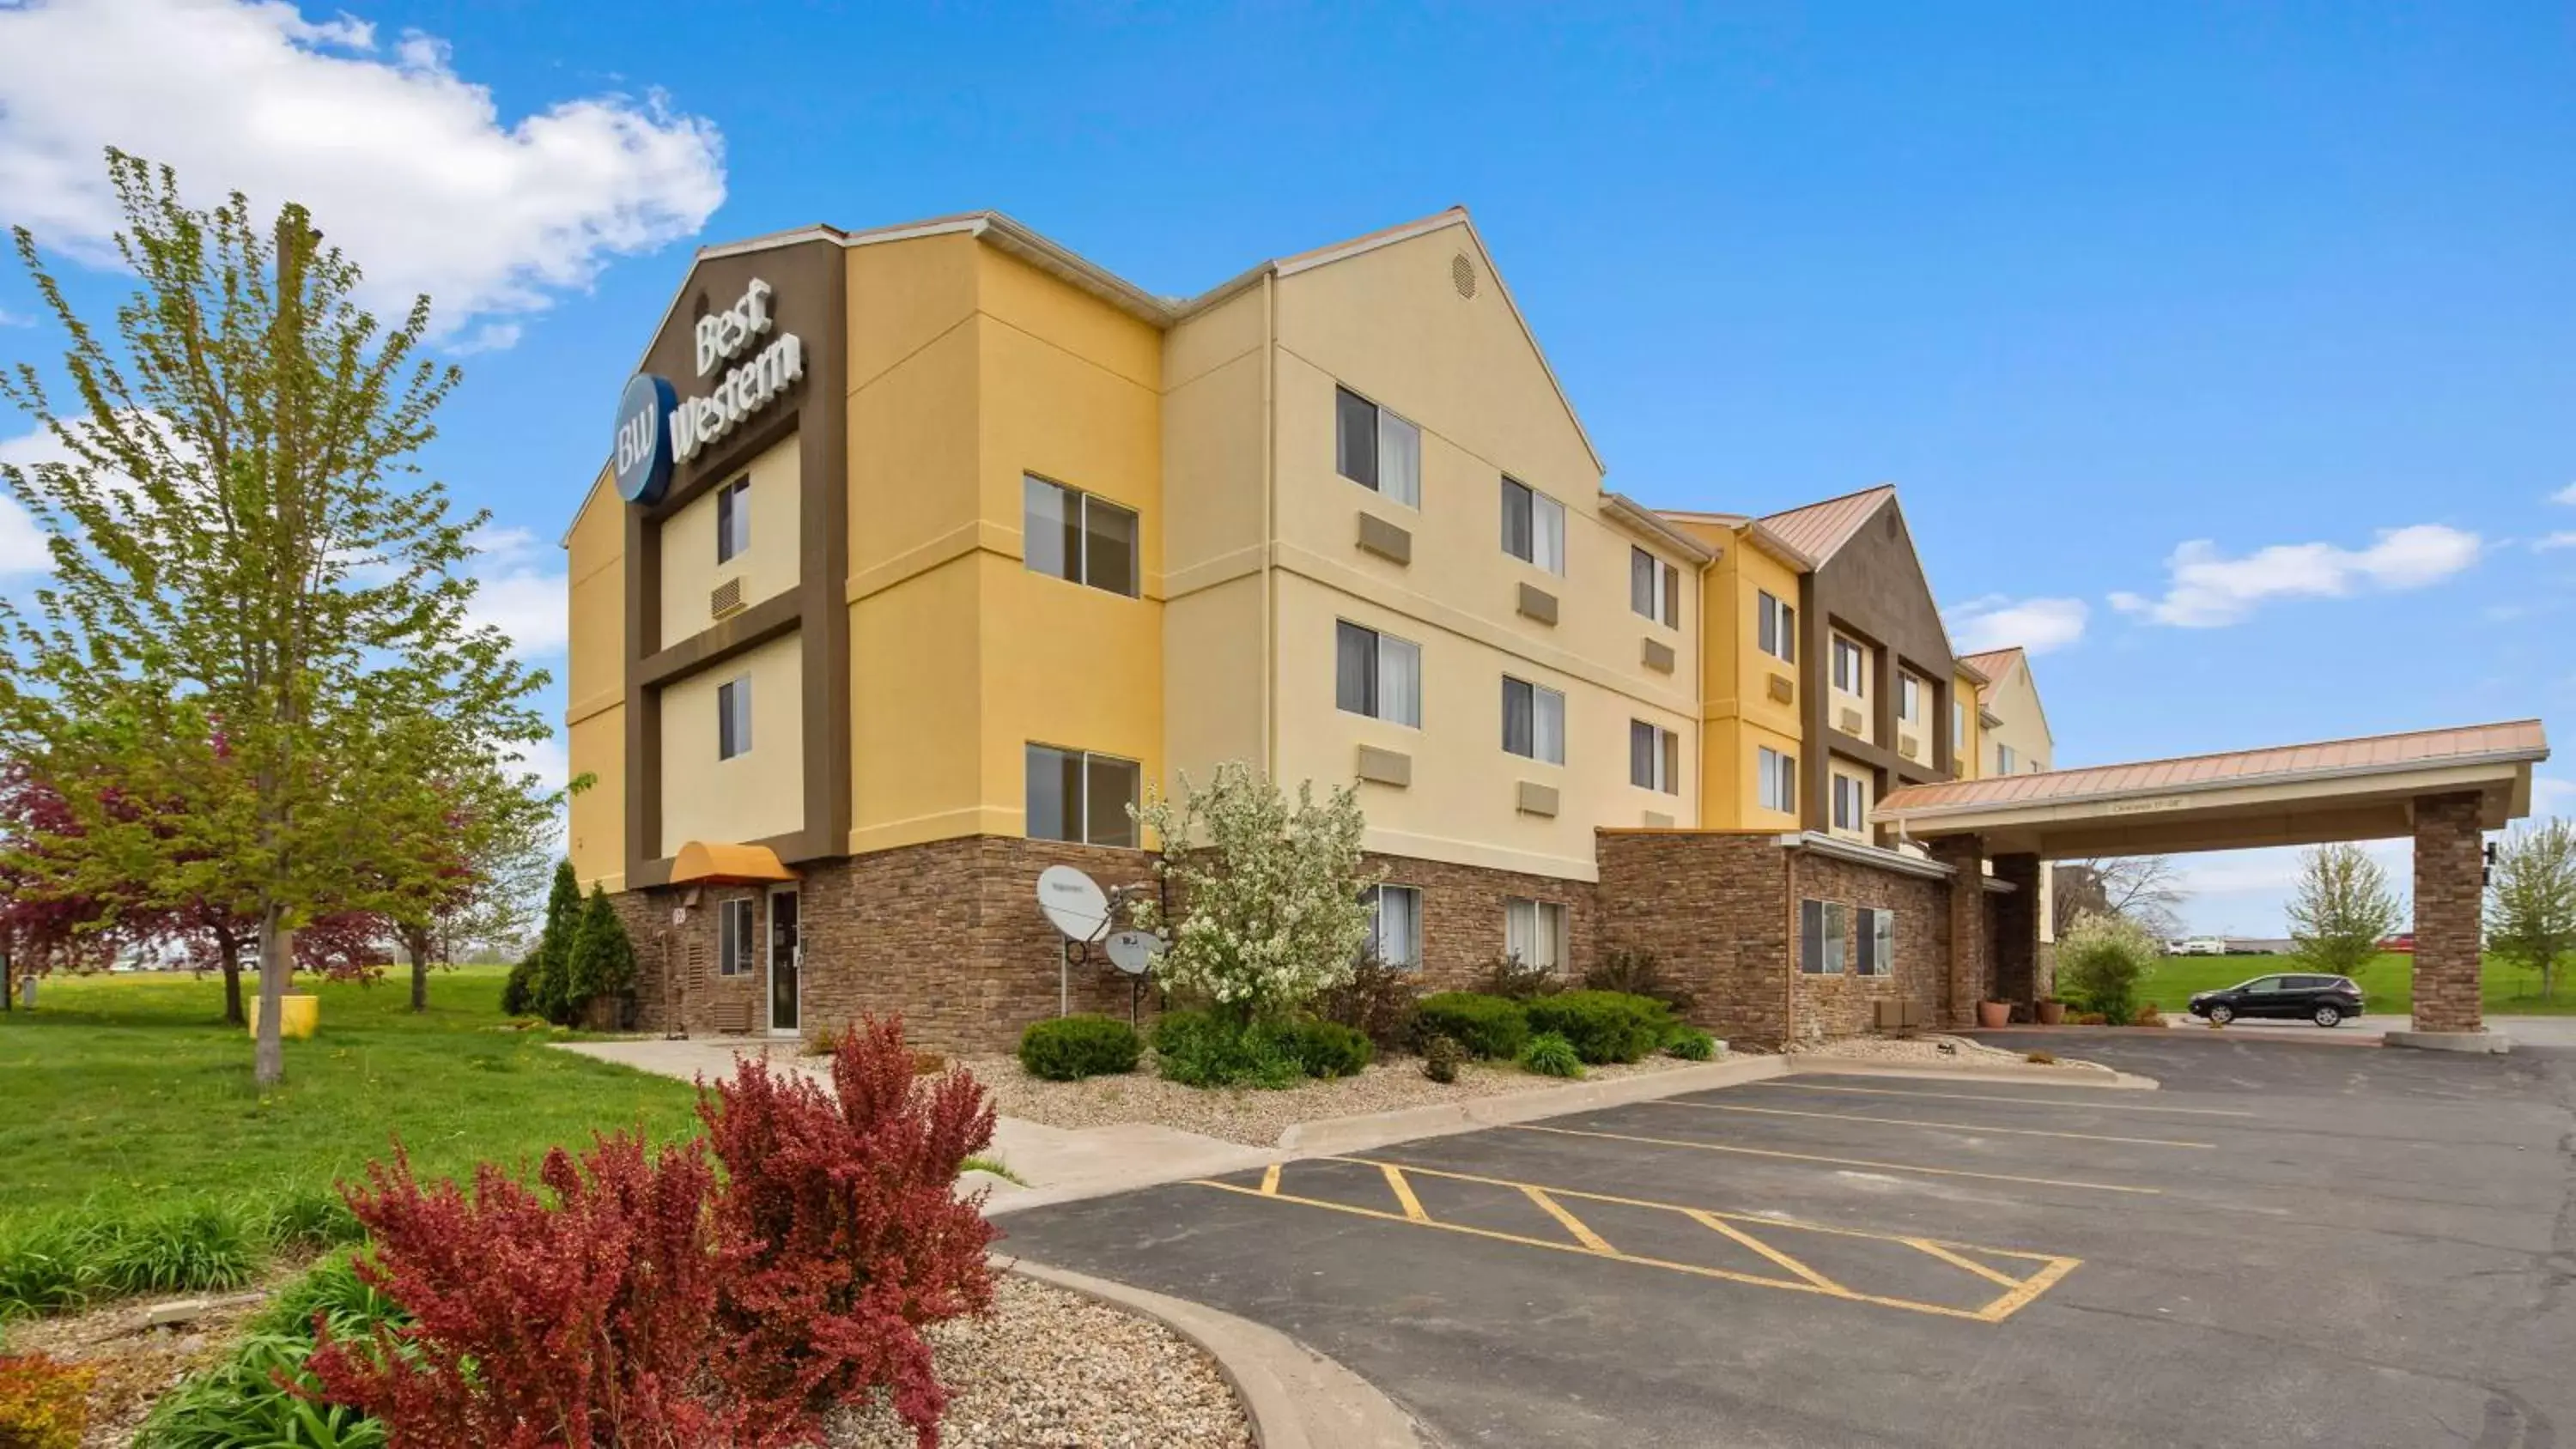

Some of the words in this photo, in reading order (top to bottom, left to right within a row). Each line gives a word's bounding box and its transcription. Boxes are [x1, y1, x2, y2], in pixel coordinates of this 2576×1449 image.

[696, 277, 772, 378] Best
[618, 403, 653, 475] BW
[669, 332, 803, 464] Western
